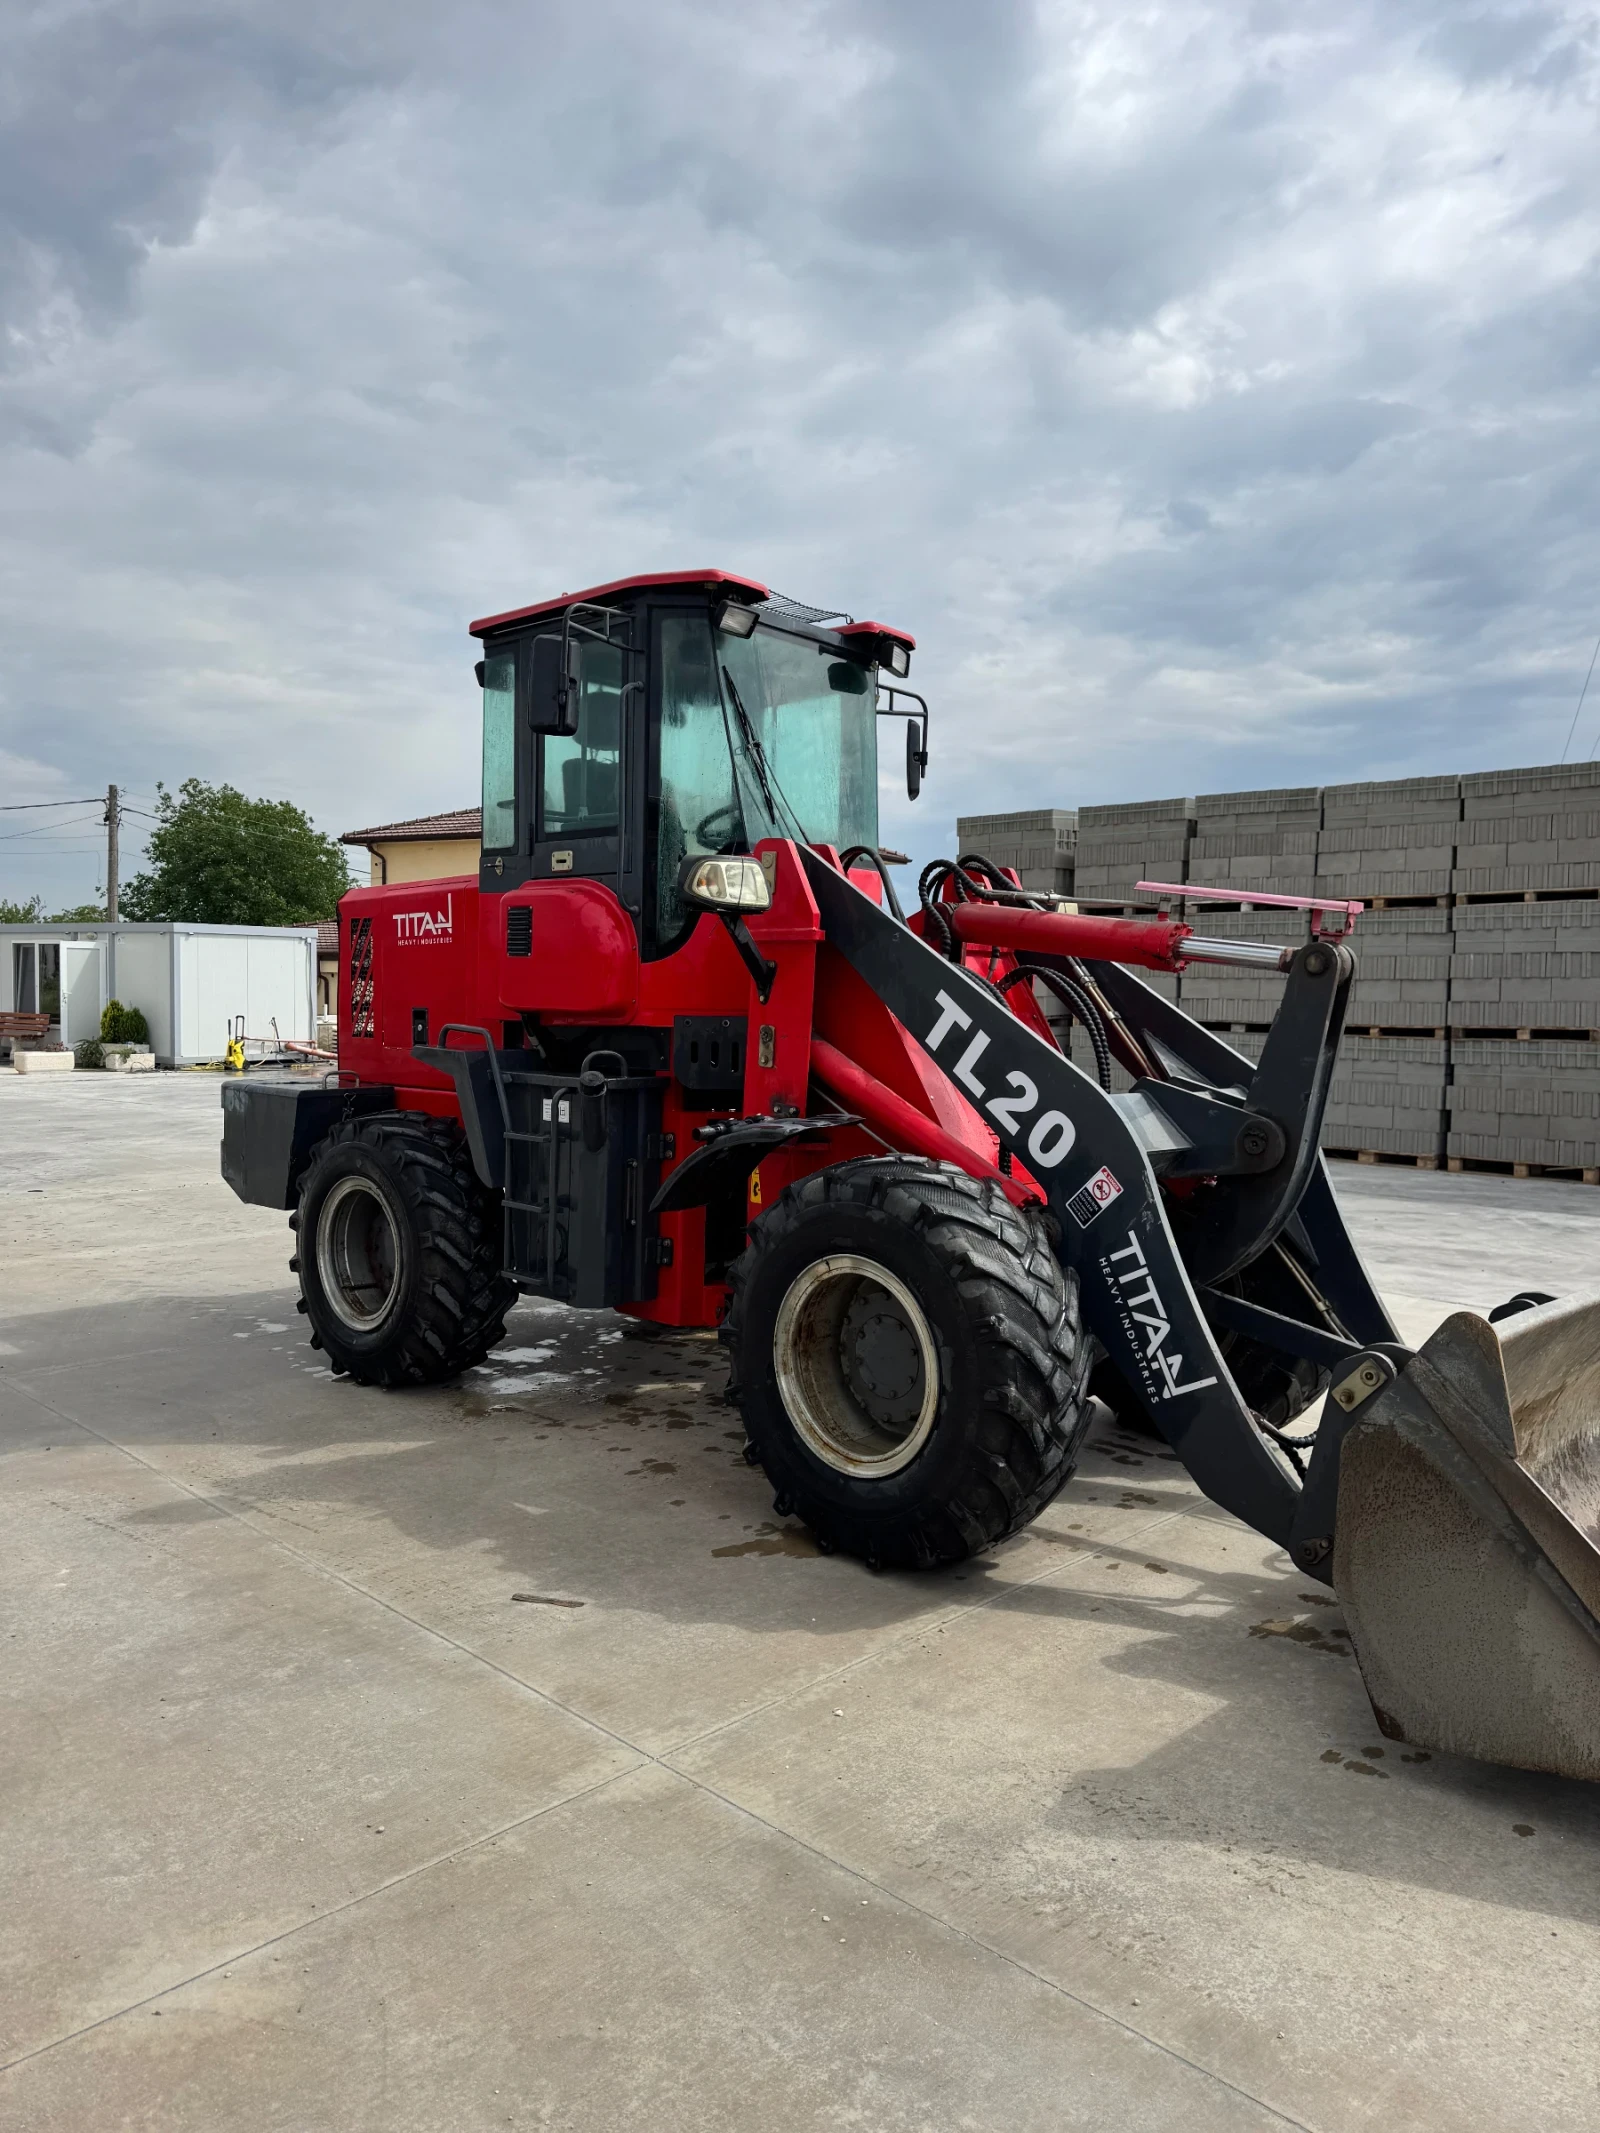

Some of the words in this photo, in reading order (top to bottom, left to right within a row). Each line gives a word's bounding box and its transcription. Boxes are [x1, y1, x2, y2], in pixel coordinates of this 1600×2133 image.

[392, 892, 453, 937] TITAN
[417, 937, 453, 945] INDUSTRIES
[924, 988, 1076, 1169] TL20
[1098, 1257, 1124, 1305] HEAVY
[1119, 1312, 1160, 1404] INDUSTRIES
[1109, 1229, 1218, 1399] TITAN
